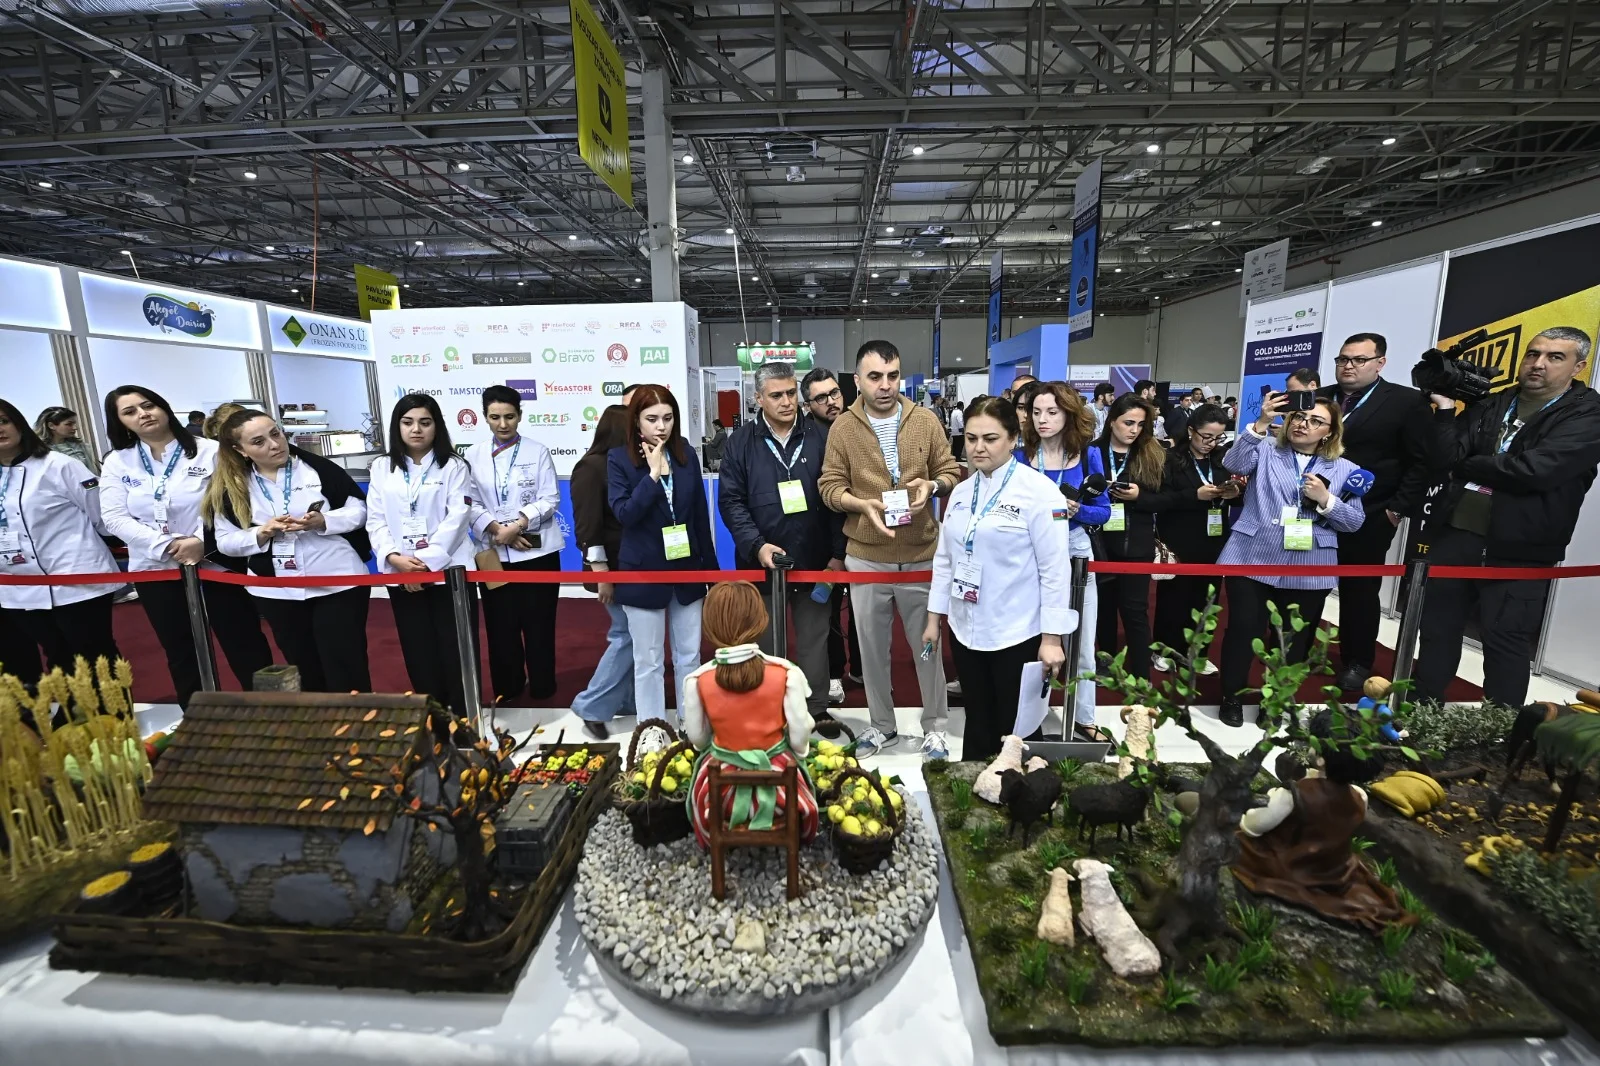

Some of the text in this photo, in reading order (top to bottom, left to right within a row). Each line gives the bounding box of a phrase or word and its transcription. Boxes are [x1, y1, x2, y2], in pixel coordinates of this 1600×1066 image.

[176, 315, 206, 328] Dairies
[310, 323, 368, 342] ONAN S.Ü.
[1254, 342, 1312, 356] GOLD SHAH 2026
[391, 354, 420, 364] araz
[484, 356, 528, 364] BAZARSTORE
[559, 352, 595, 363] Bravo
[643, 349, 666, 362] ДА!
[544, 382, 593, 392] MEGASTORE
[528, 413, 558, 423] araz
[550, 448, 578, 456] aleon
[998, 504, 1020, 515] ACSA
